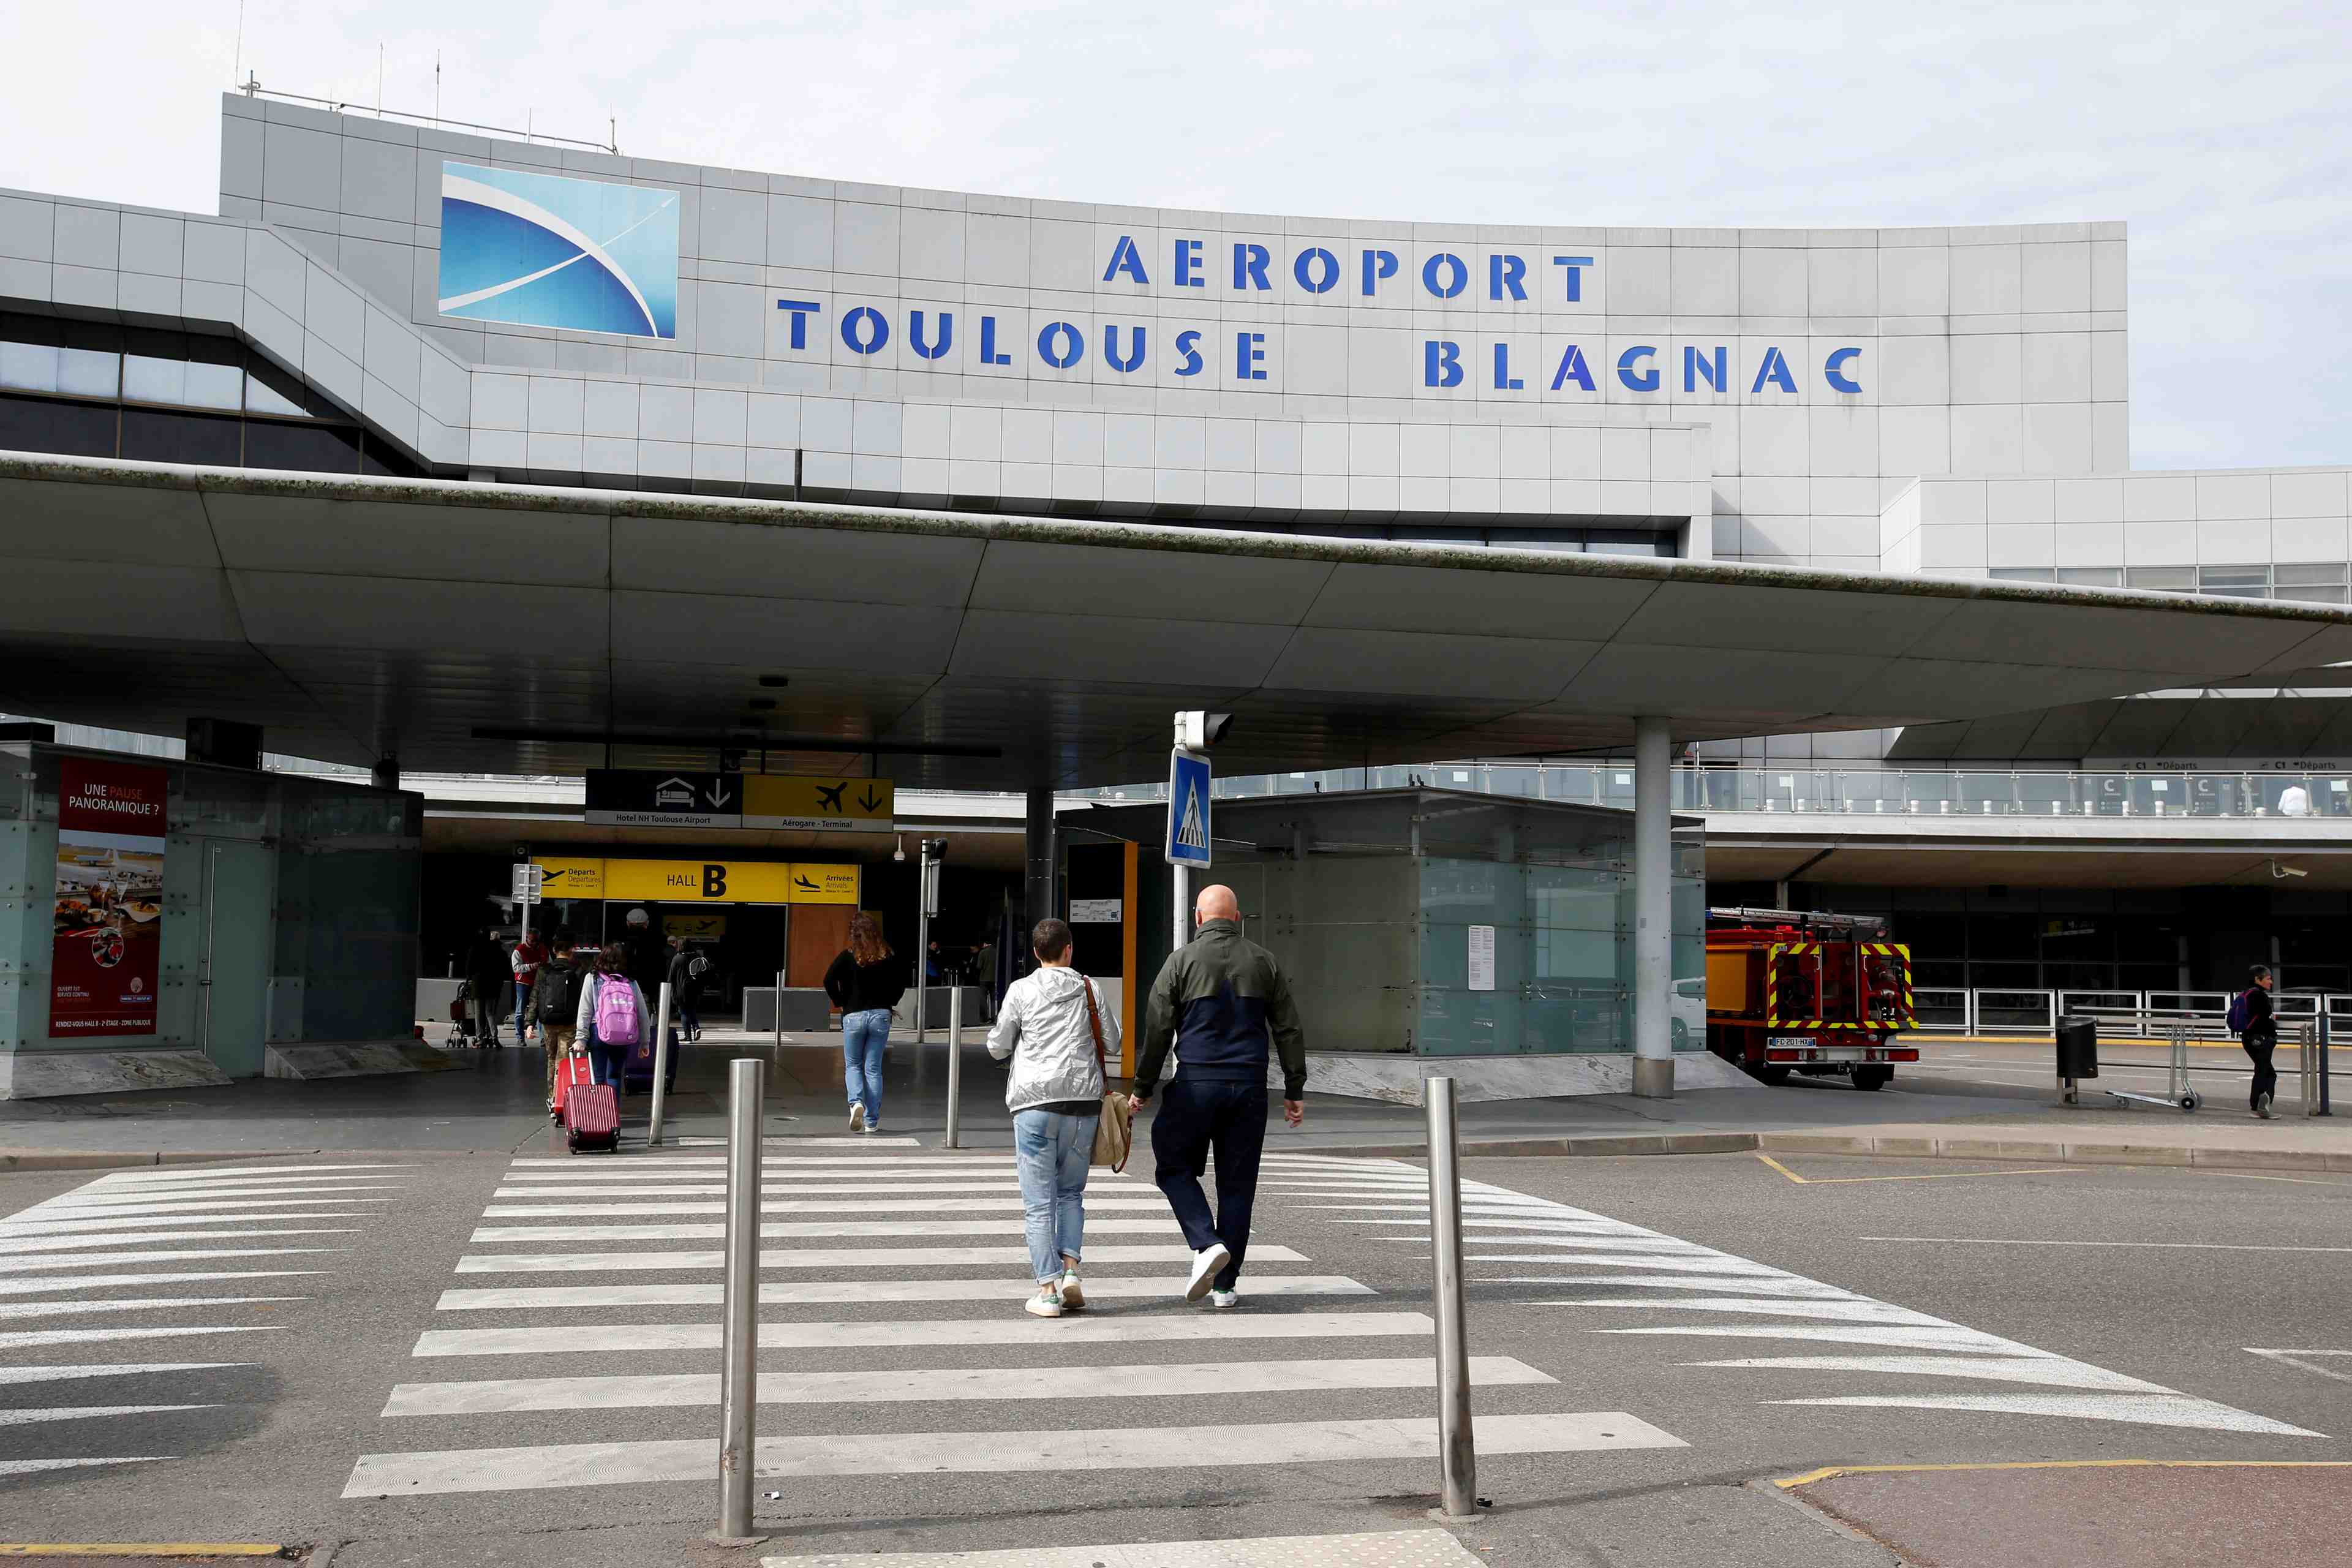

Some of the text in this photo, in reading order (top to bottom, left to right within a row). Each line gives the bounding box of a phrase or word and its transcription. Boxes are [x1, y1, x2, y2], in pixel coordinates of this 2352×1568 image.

[1102, 235, 1594, 303] AEROPORT
[777, 298, 1863, 394] TOULOUSE BLAGNAC
[2163, 761, 2198, 771] Départs
[2300, 761, 2336, 771] Départs
[85, 783, 143, 800] UNE PAUSE
[2103, 779, 2114, 792] C
[2198, 779, 2208, 792] C
[69, 796, 159, 815] PANORAMIQUE ?
[782, 819, 816, 828] Aérogare
[568, 868, 596, 876] Départs
[667, 864, 727, 897] HALL B
